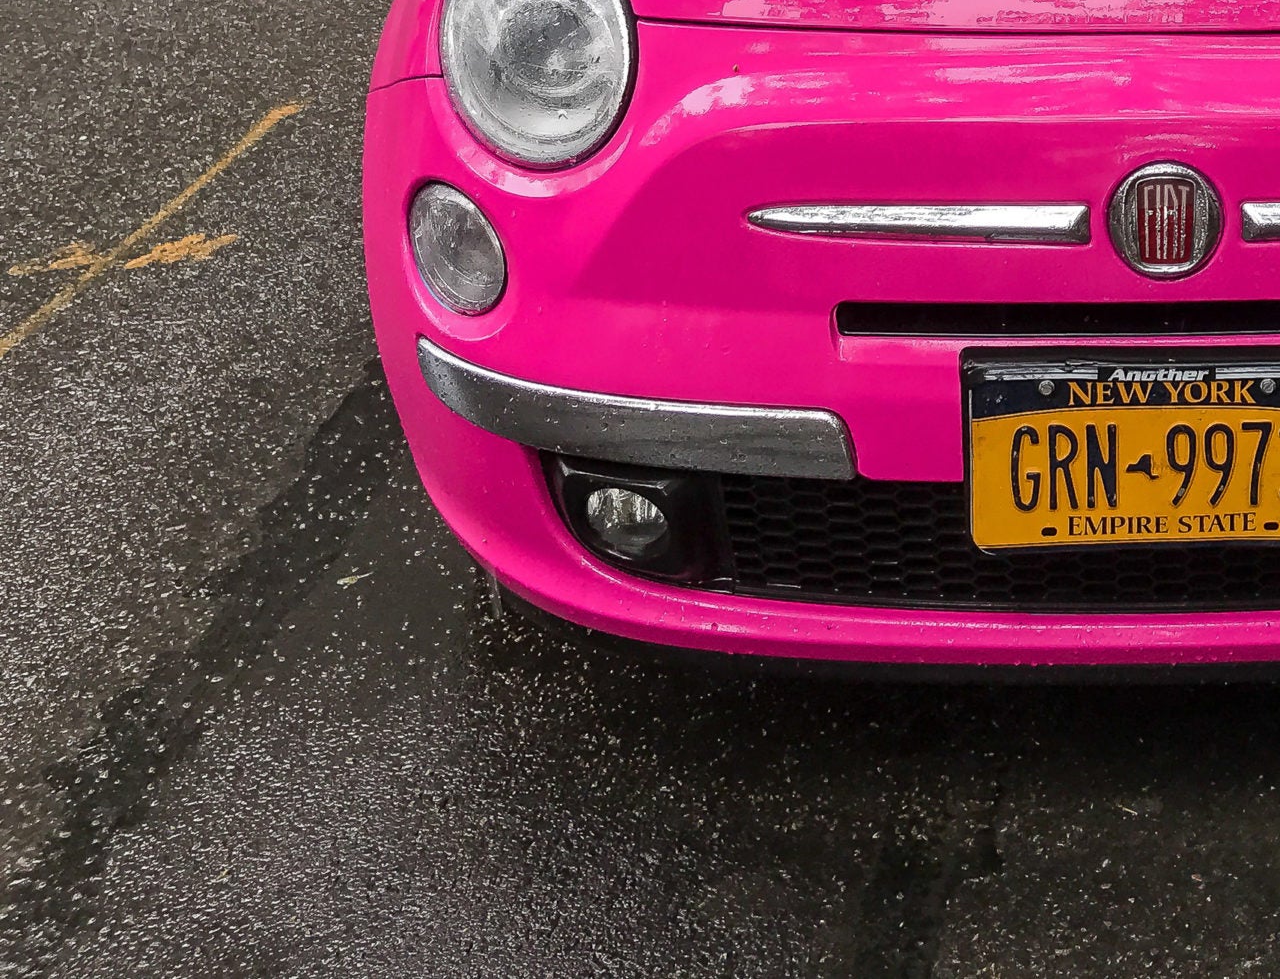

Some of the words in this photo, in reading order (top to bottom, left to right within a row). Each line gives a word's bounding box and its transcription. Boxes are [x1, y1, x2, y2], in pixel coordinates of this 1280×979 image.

[1143, 183, 1191, 260] FIAT
[1108, 368, 1210, 382] Another
[1067, 380, 1150, 406] NEW
[1168, 379, 1257, 405] YORK
[1067, 515, 1169, 537] EMPIRE
[1177, 512, 1257, 534] STATE
